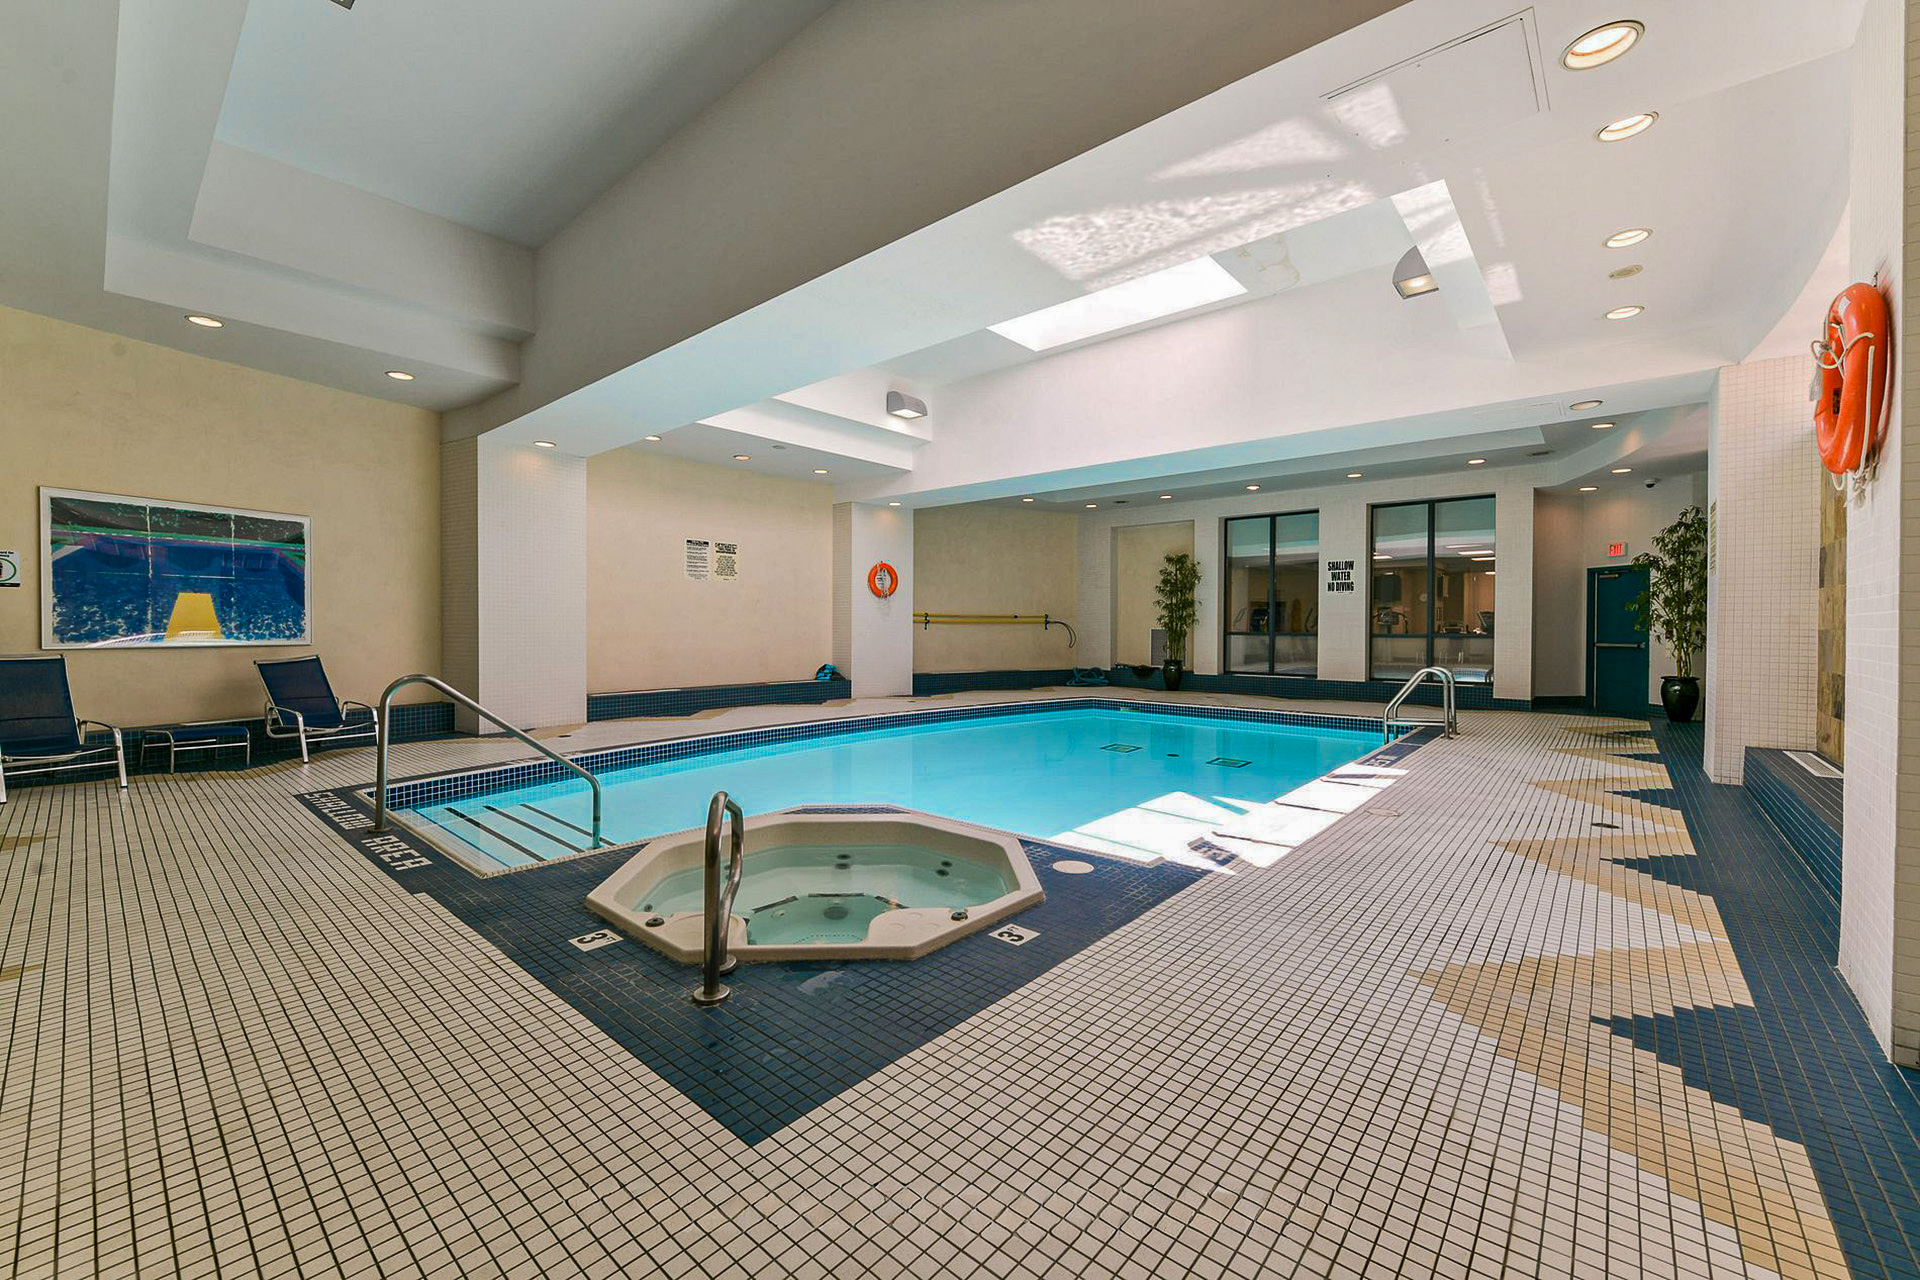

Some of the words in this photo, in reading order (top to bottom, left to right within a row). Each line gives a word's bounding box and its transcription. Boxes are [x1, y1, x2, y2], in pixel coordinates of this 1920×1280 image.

[1327, 560, 1355, 571] SHALLOW
[1331, 571, 1351, 581] WATER
[1327, 582, 1335, 592] NO
[1335, 581, 1355, 592] DIVING
[303, 791, 376, 830] SHALLOW
[361, 835, 433, 871] AREA
[577, 932, 608, 944] 3
[997, 931, 1024, 942] 3
